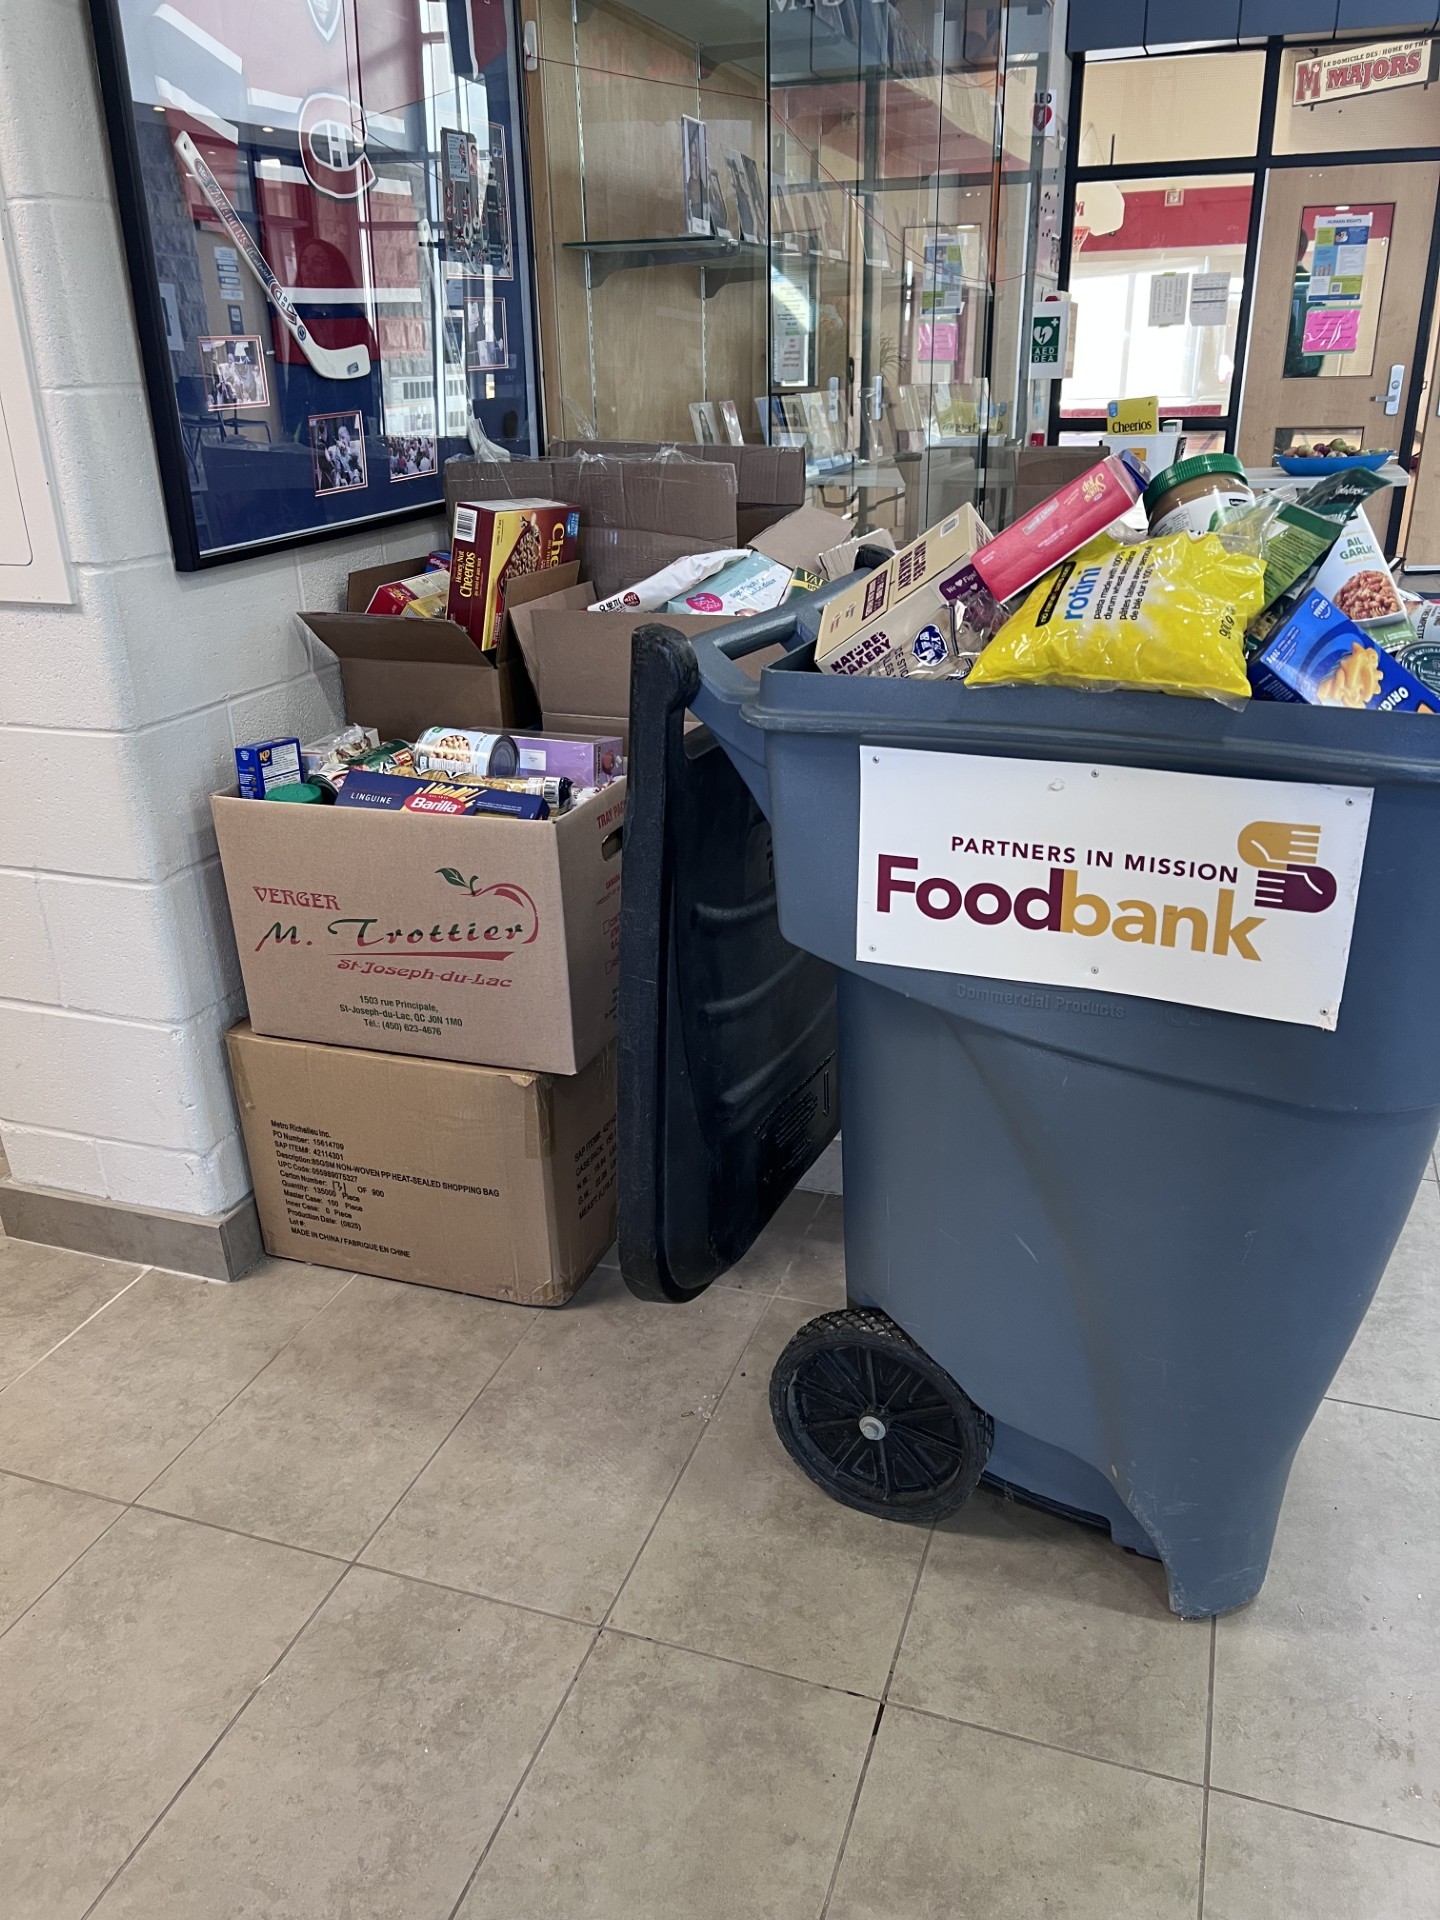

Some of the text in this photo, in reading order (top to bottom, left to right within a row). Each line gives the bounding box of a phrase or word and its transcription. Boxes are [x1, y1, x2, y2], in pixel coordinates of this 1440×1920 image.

[1324, 60, 1332, 68] LE
[1332, 53, 1364, 66] DOMICILE
[1366, 50, 1378, 59] DES
[1382, 44, 1402, 56] HOME
[1404, 42, 1412, 50] OF
[1413, 40, 1428, 48] THE
[1326, 48, 1422, 92] MAJORS
[1033, 92, 1052, 104] AED
[1034, 346, 1055, 355] AED
[1034, 354, 1055, 363] DEA
[1112, 420, 1152, 434] Cheerios
[1346, 536, 1364, 548] AIL
[456, 560, 464, 584] Honey
[459, 552, 476, 599] Cheerios
[898, 551, 912, 591] BAKERY
[1064, 566, 1102, 621] rotini
[1093, 599, 1104, 620] pasta
[1100, 582, 1110, 599] made
[1104, 594, 1115, 620] durum
[1112, 575, 1124, 596] wheat
[1119, 598, 1130, 620] pâtes
[1126, 580, 1136, 599] faites
[1138, 585, 1146, 598] dur
[1134, 598, 1143, 610] blé
[1130, 609, 1139, 620] de
[897, 658, 908, 678] STIC
[1378, 686, 1409, 711] ORIG
[259, 750, 270, 762] KD
[350, 792, 393, 805] LINGUINE
[410, 796, 458, 814] Barilla
[596, 812, 614, 830] TRAY
[951, 836, 1238, 884] PARTNERS IN MISSION
[252, 886, 341, 910] VERGER
[876, 853, 1268, 962] Foodbank
[255, 918, 523, 952] M. Trottier
[337, 959, 513, 988] St-Joseph-du-Lac
[360, 995, 438, 1014] 1503 rue Principale,
[956, 983, 1126, 1019] Commercial Products
[340, 1004, 413, 1022] St-Joseph-du-Lac,
[414, 1014, 426, 1024] QC
[382, 1020, 402, 1032] (450)
[404, 1022, 442, 1036] 623-4676
[271, 1120, 332, 1138] Metro Richelieu Inc.
[272, 1130, 282, 1138] PO
[284, 1132, 310, 1144] Number:
[274, 1140, 288, 1149] SAP
[313, 1148, 344, 1160] 42114301
[278, 1160, 292, 1170] UPC
[294, 1164, 312, 1174] Code:
[280, 1170, 328, 1186] Carton Number:
[336, 1160, 380, 1177] NON-WOVEN
[381, 1170, 391, 1179] PP
[392, 1174, 441, 1188] HEAT-SEALED
[442, 1182, 482, 1195] SHOPPING
[482, 1188, 500, 1197] BAG
[282, 1180, 310, 1192] Quantity:
[342, 1192, 360, 1203] Piece
[284, 1188, 304, 1200] Master
[304, 1194, 324, 1204] Case:
[344, 1202, 363, 1212] Piece
[357, 1186, 368, 1194] OF
[286, 1198, 300, 1208] Inner
[302, 1202, 320, 1212] Case:
[334, 1208, 352, 1219] Piece
[287, 1208, 320, 1221] Production
[320, 1215, 337, 1224] Date:
[289, 1218, 300, 1226] Lot
[291, 1227, 310, 1236] MADE
[319, 1233, 340, 1244] CHINA
[344, 1238, 378, 1252] FABRIQUE
[379, 1246, 389, 1254] EN
[390, 1248, 410, 1258] CHINE
